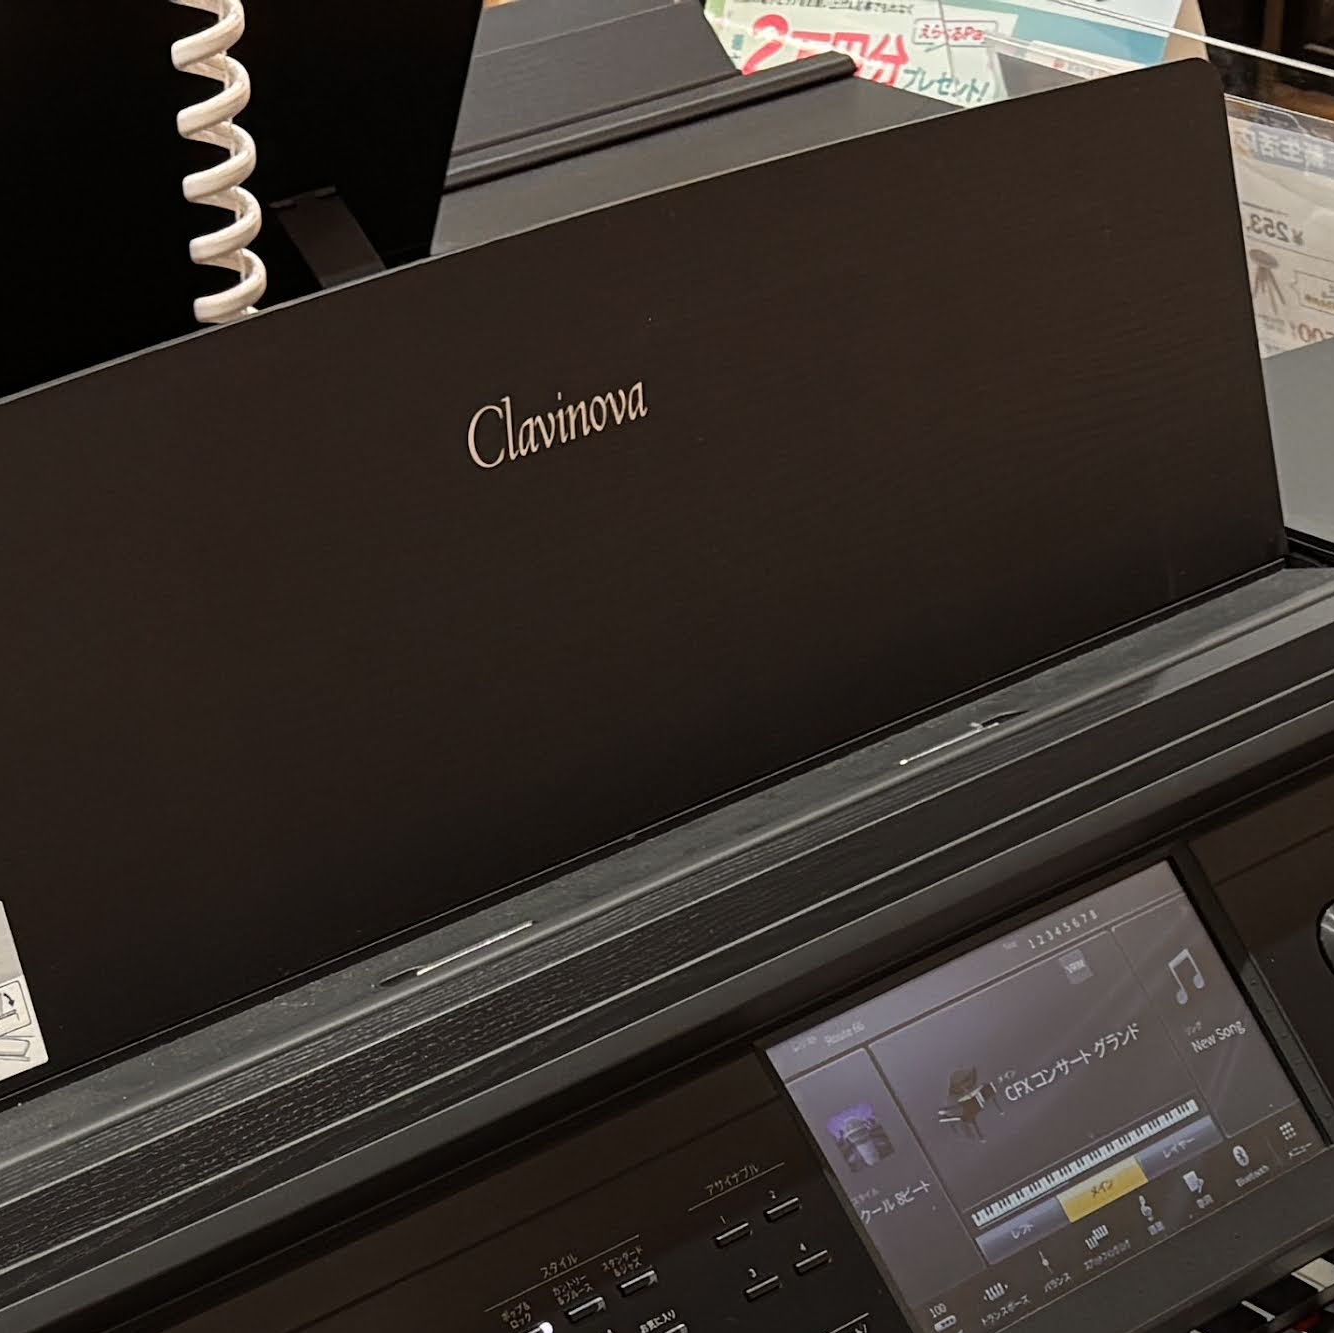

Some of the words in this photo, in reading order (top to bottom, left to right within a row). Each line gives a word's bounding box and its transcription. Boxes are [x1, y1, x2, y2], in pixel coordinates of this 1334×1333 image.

[467, 381, 649, 469] Clavinova
[1028, 939, 1036, 950] 1
[1037, 935, 1046, 946] 2
[1046, 930, 1054, 941] 3
[1054, 926, 1063, 937] 4
[1063, 922, 1072, 933] 5
[1071, 917, 1080, 928] 6
[1080, 913, 1089, 924] 7
[1190, 1035, 1216, 1054] New
[1215, 1020, 1247, 1044] Song
[1004, 1080, 1035, 1101] CFX
[1031, 1049, 1093, 1089] コンサート
[1094, 1022, 1141, 1059] グランド
[705, 1164, 759, 1197] アサイナブル
[859, 1199, 896, 1225] クール
[894, 1179, 933, 1207] 8ビート
[540, 1253, 578, 1279] スタイル
[928, 1301, 948, 1319] 100
[980, 1294, 1032, 1327] トランスポーズ
